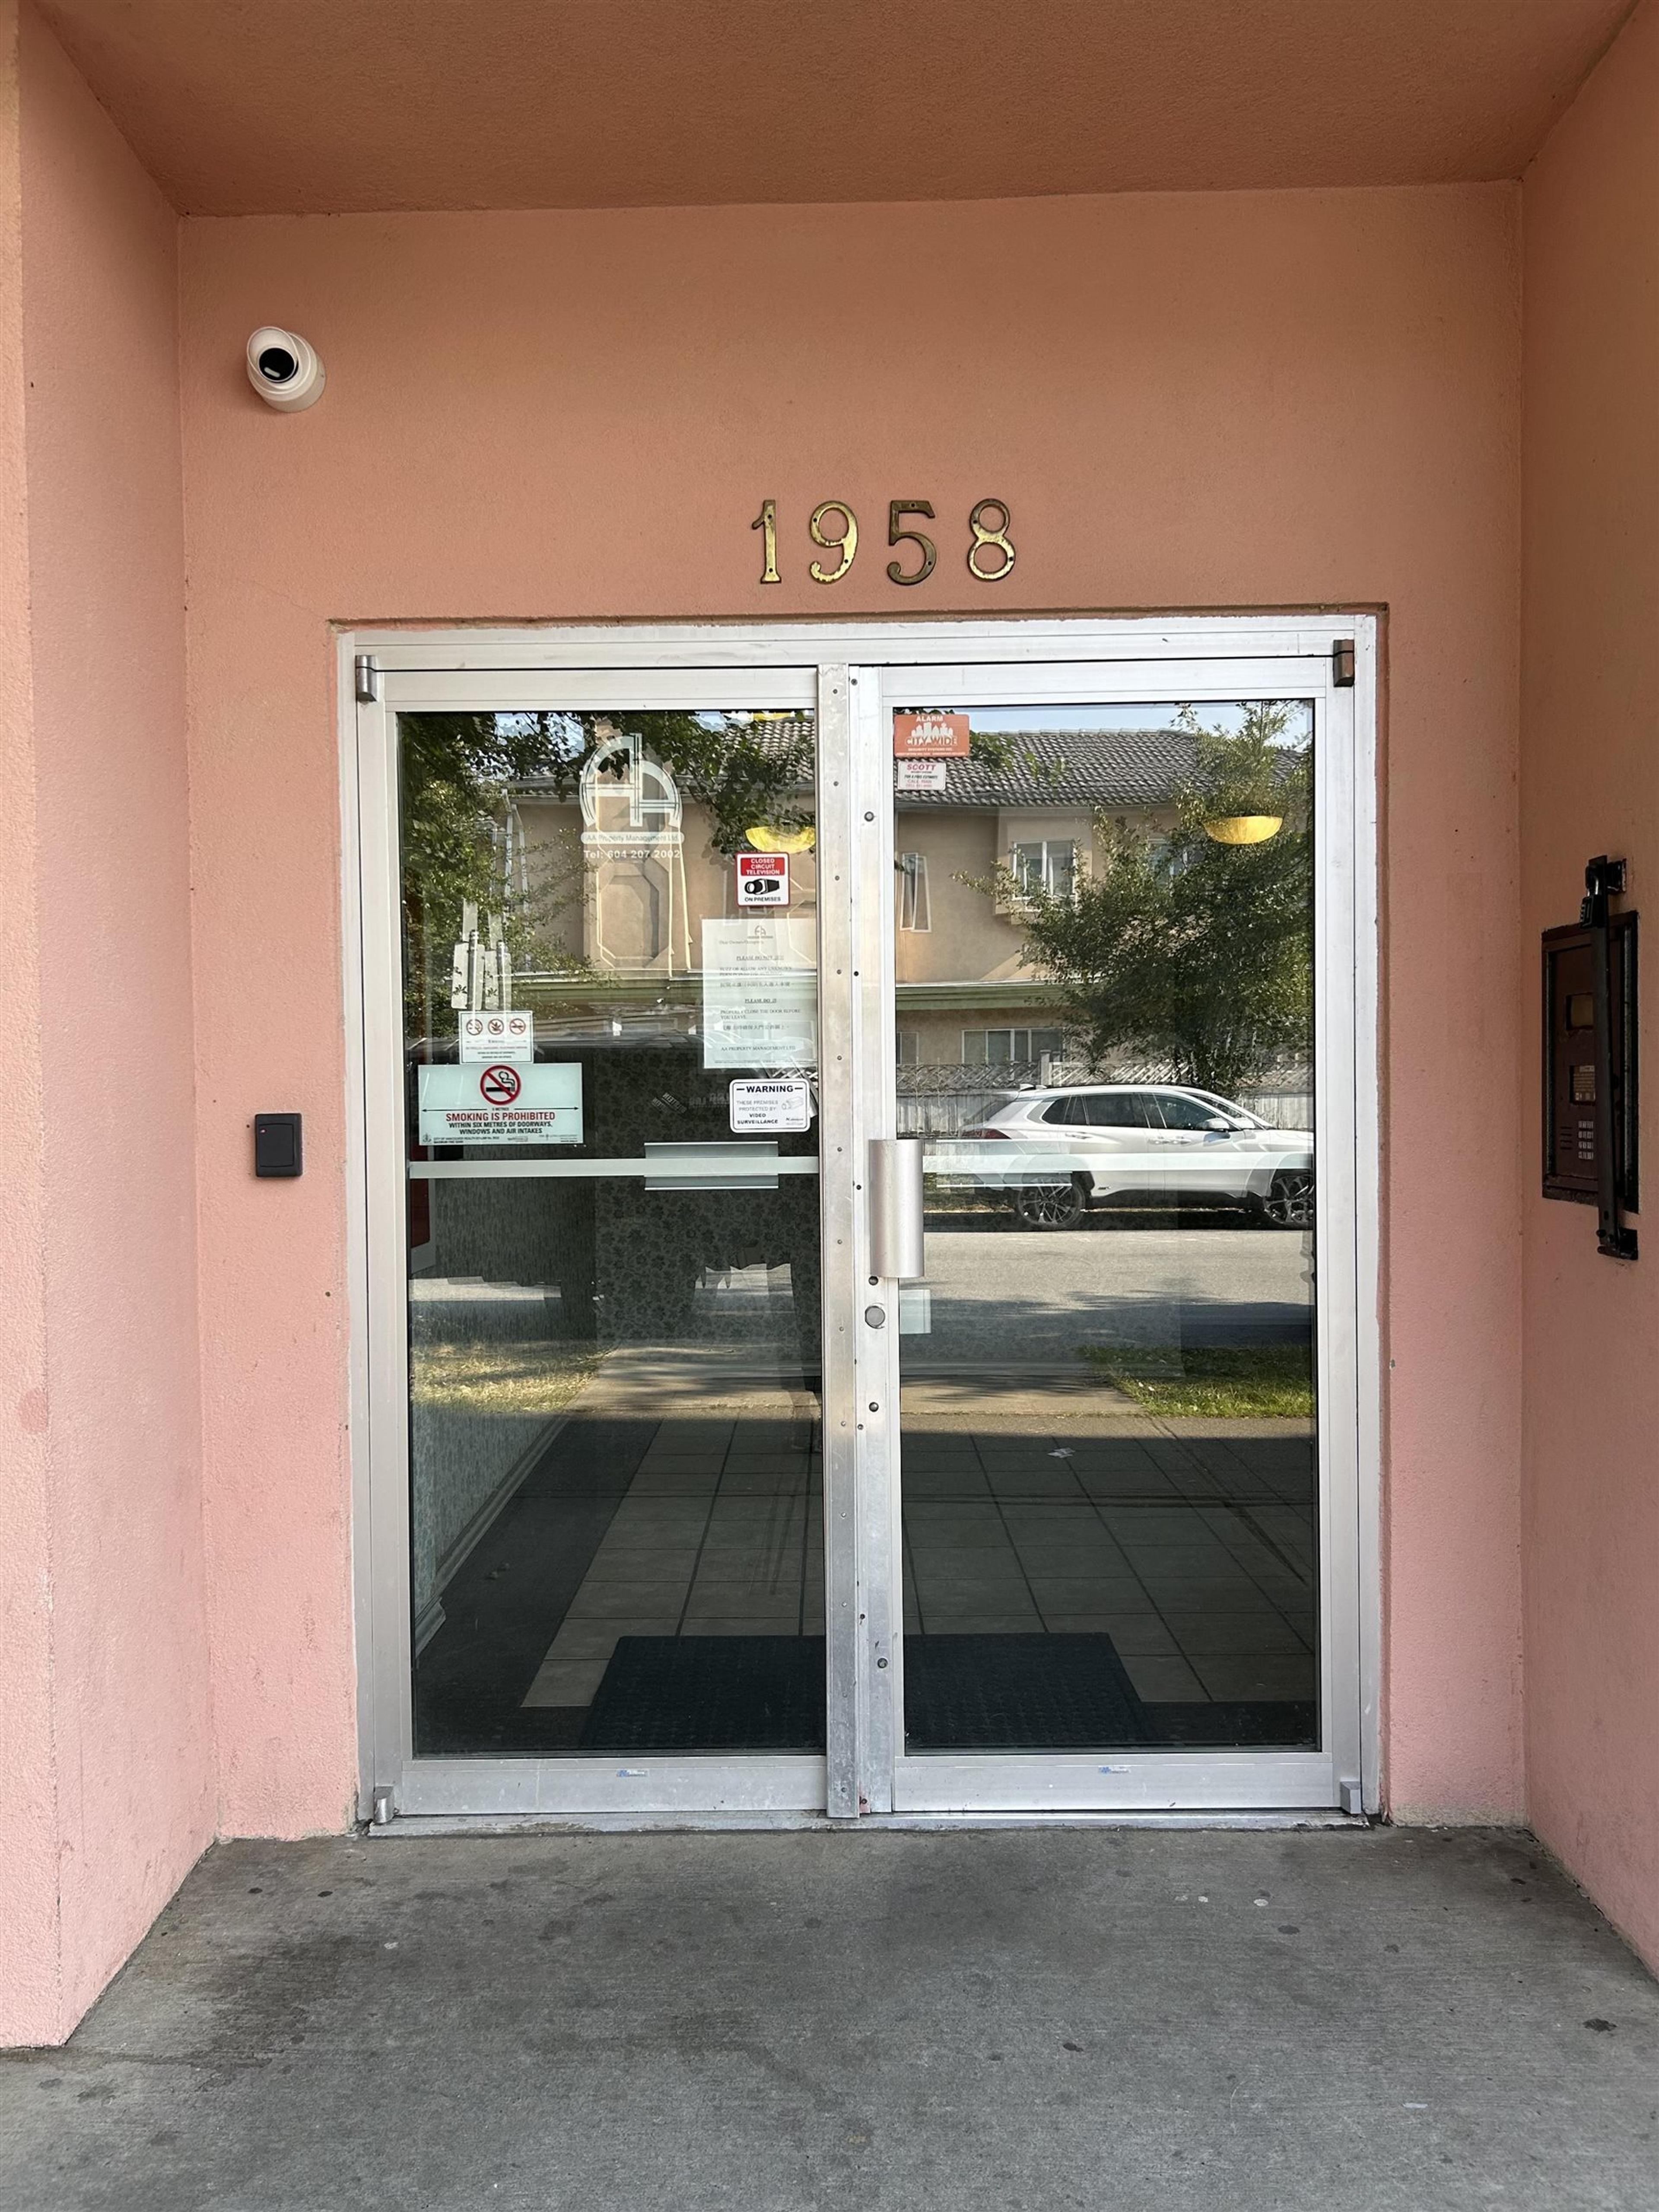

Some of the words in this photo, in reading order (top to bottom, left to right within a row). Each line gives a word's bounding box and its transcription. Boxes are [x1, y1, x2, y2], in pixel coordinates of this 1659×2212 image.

[751, 498, 1016, 586] 1958
[584, 850, 603, 858] Tel:
[608, 850, 626, 858] 604
[446, 1113, 489, 1122] SMOKING
[502, 1112, 555, 1120] PROHIBITED
